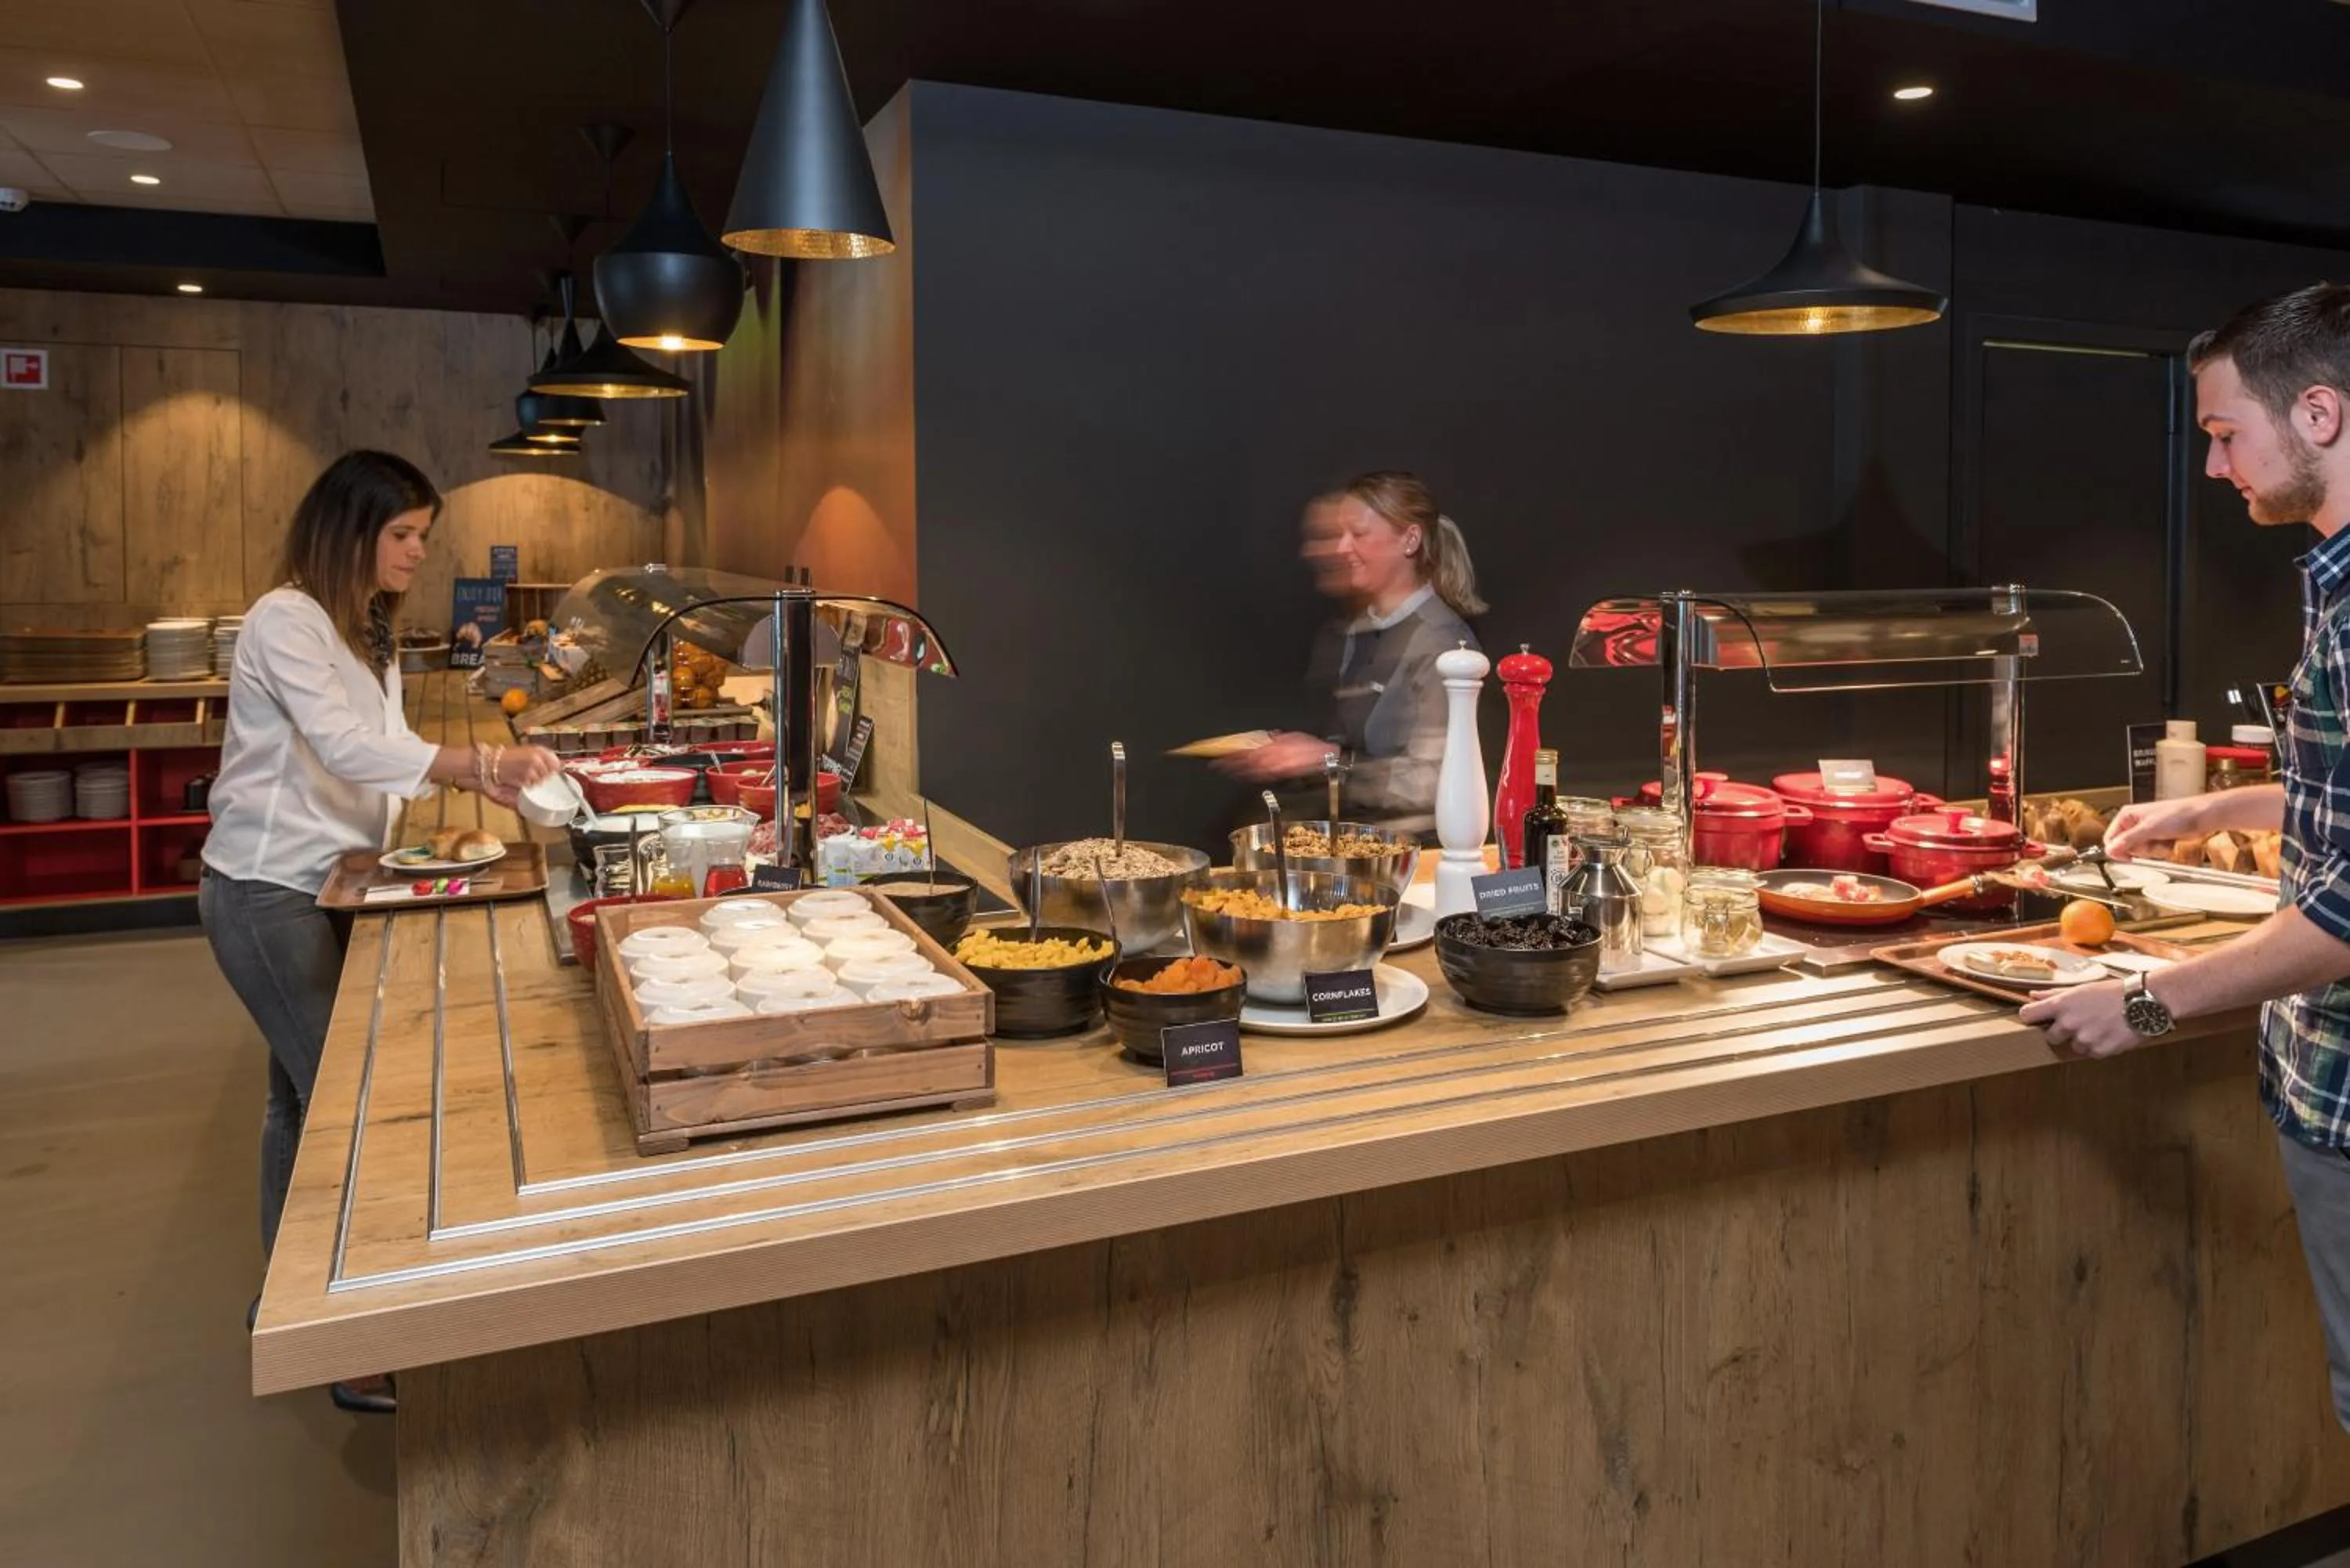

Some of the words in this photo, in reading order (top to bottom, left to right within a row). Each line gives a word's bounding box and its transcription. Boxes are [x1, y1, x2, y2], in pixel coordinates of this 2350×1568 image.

[1479, 887, 1506, 900] DRIED
[1508, 883, 1539, 894] FRUITS
[1312, 987, 1372, 1002] CORNFLAKES
[1180, 1040, 1224, 1057] APRICOT
